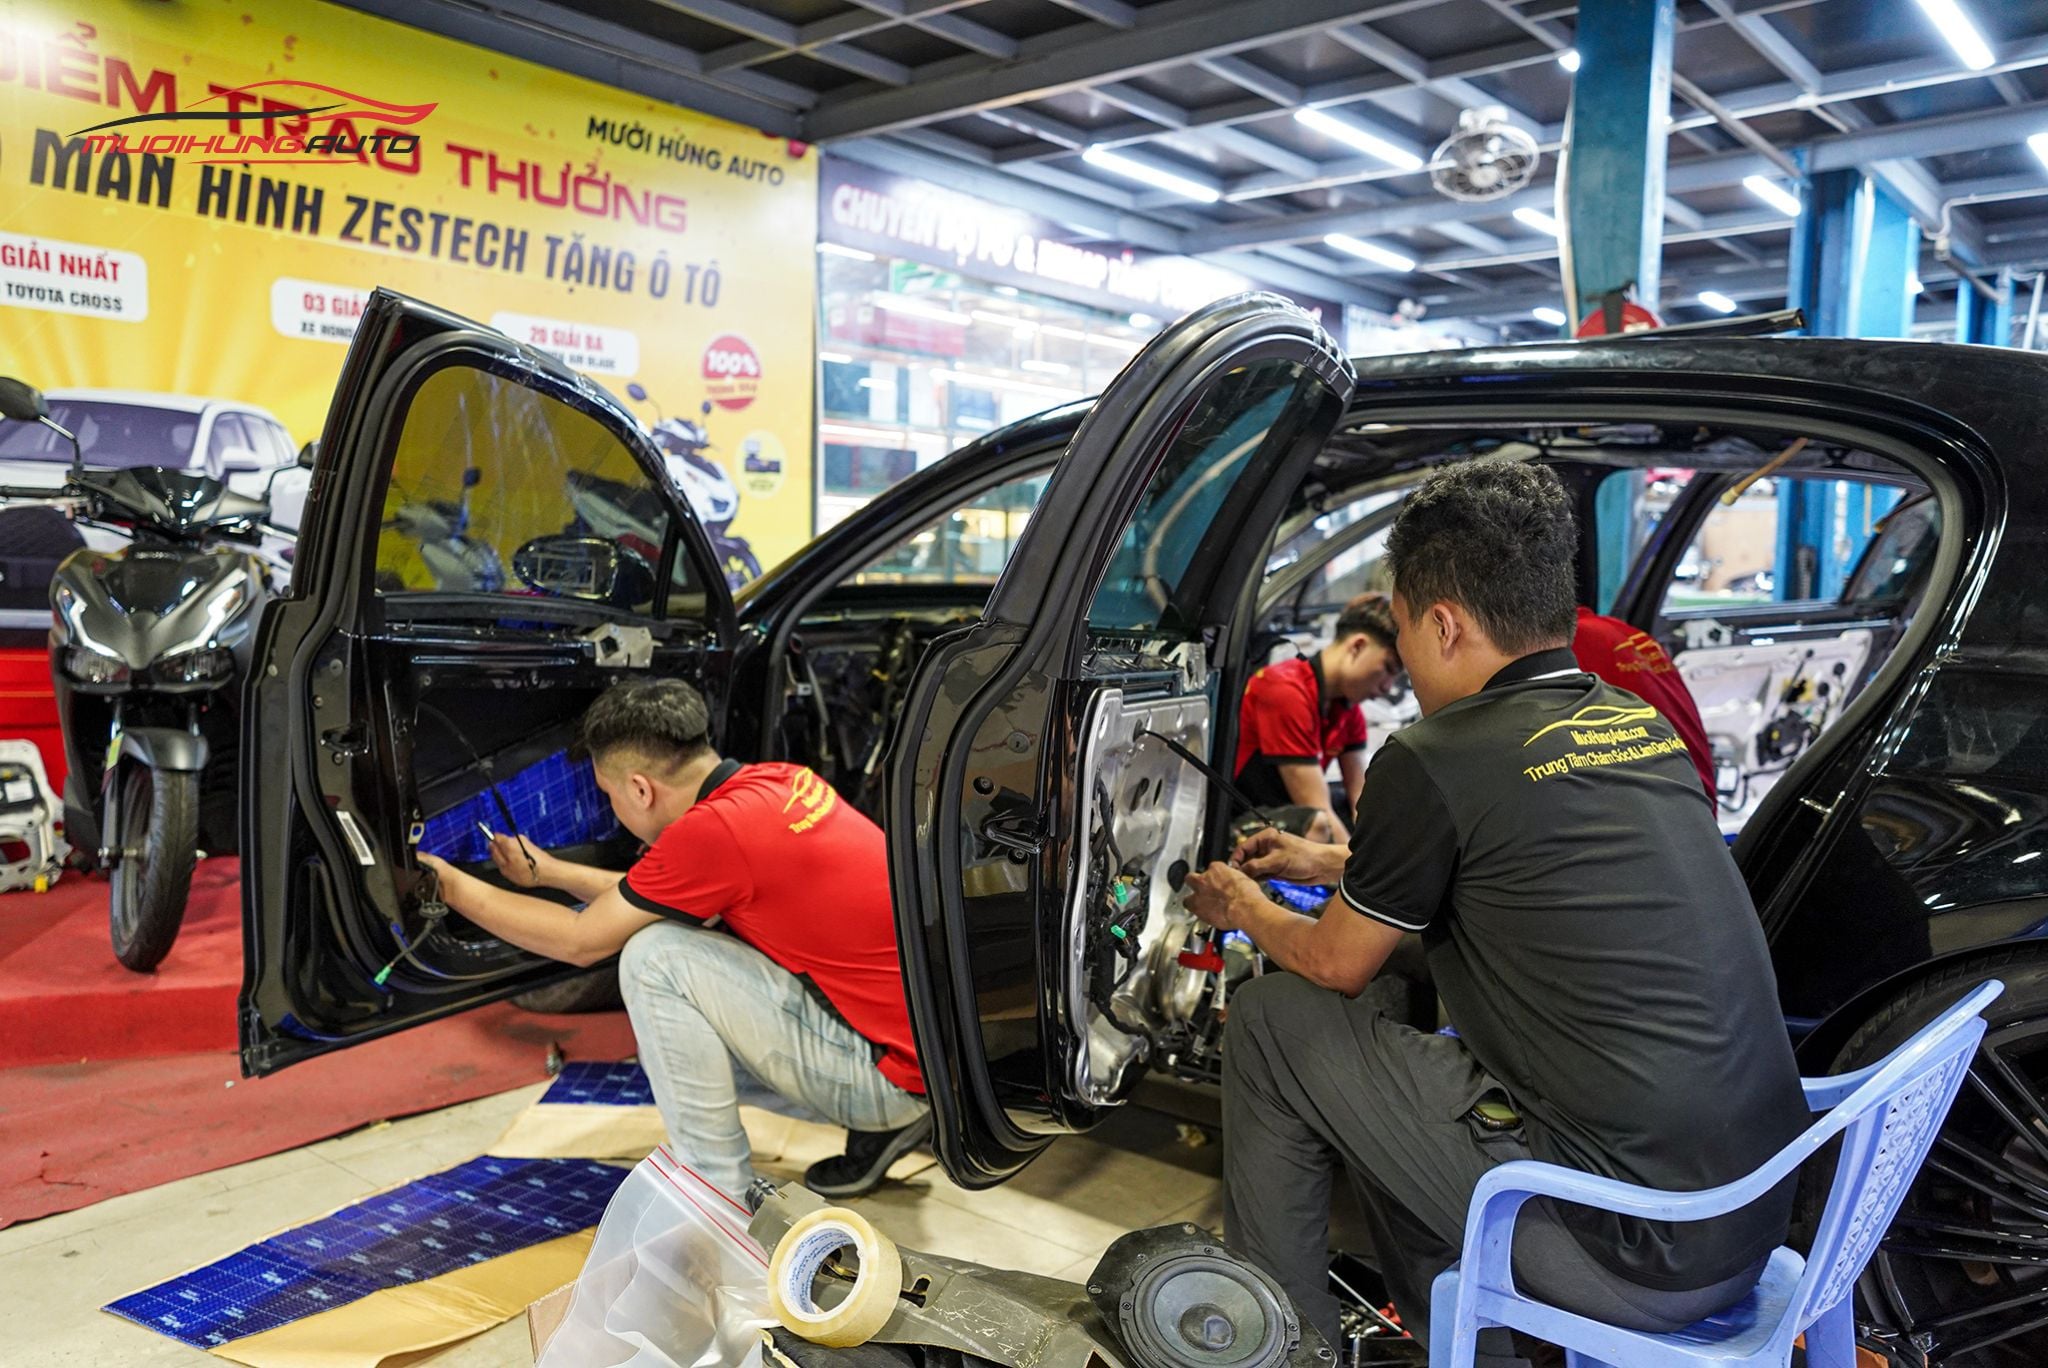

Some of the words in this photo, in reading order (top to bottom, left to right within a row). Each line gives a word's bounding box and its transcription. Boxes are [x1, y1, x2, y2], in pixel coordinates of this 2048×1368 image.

[585, 114, 653, 155] MƯỜI
[727, 155, 785, 187] AUTO
[445, 143, 689, 235] THƯỞNG
[197, 161, 325, 236] HÌNH
[339, 194, 529, 274] ZESTECH
[544, 232, 635, 294] TẶNG
[648, 249, 672, 300] Ô
[684, 259, 722, 308] TÔ
[1, 240, 50, 272] GIẢI
[59, 250, 121, 282] NHẤT
[6, 282, 64, 304] TOYOTA
[69, 291, 123, 313] CROSS
[303, 292, 325, 313] 03
[332, 293, 366, 318] GIẢ
[707, 349, 758, 376] 100%
[1523, 757, 1569, 782] Trung
